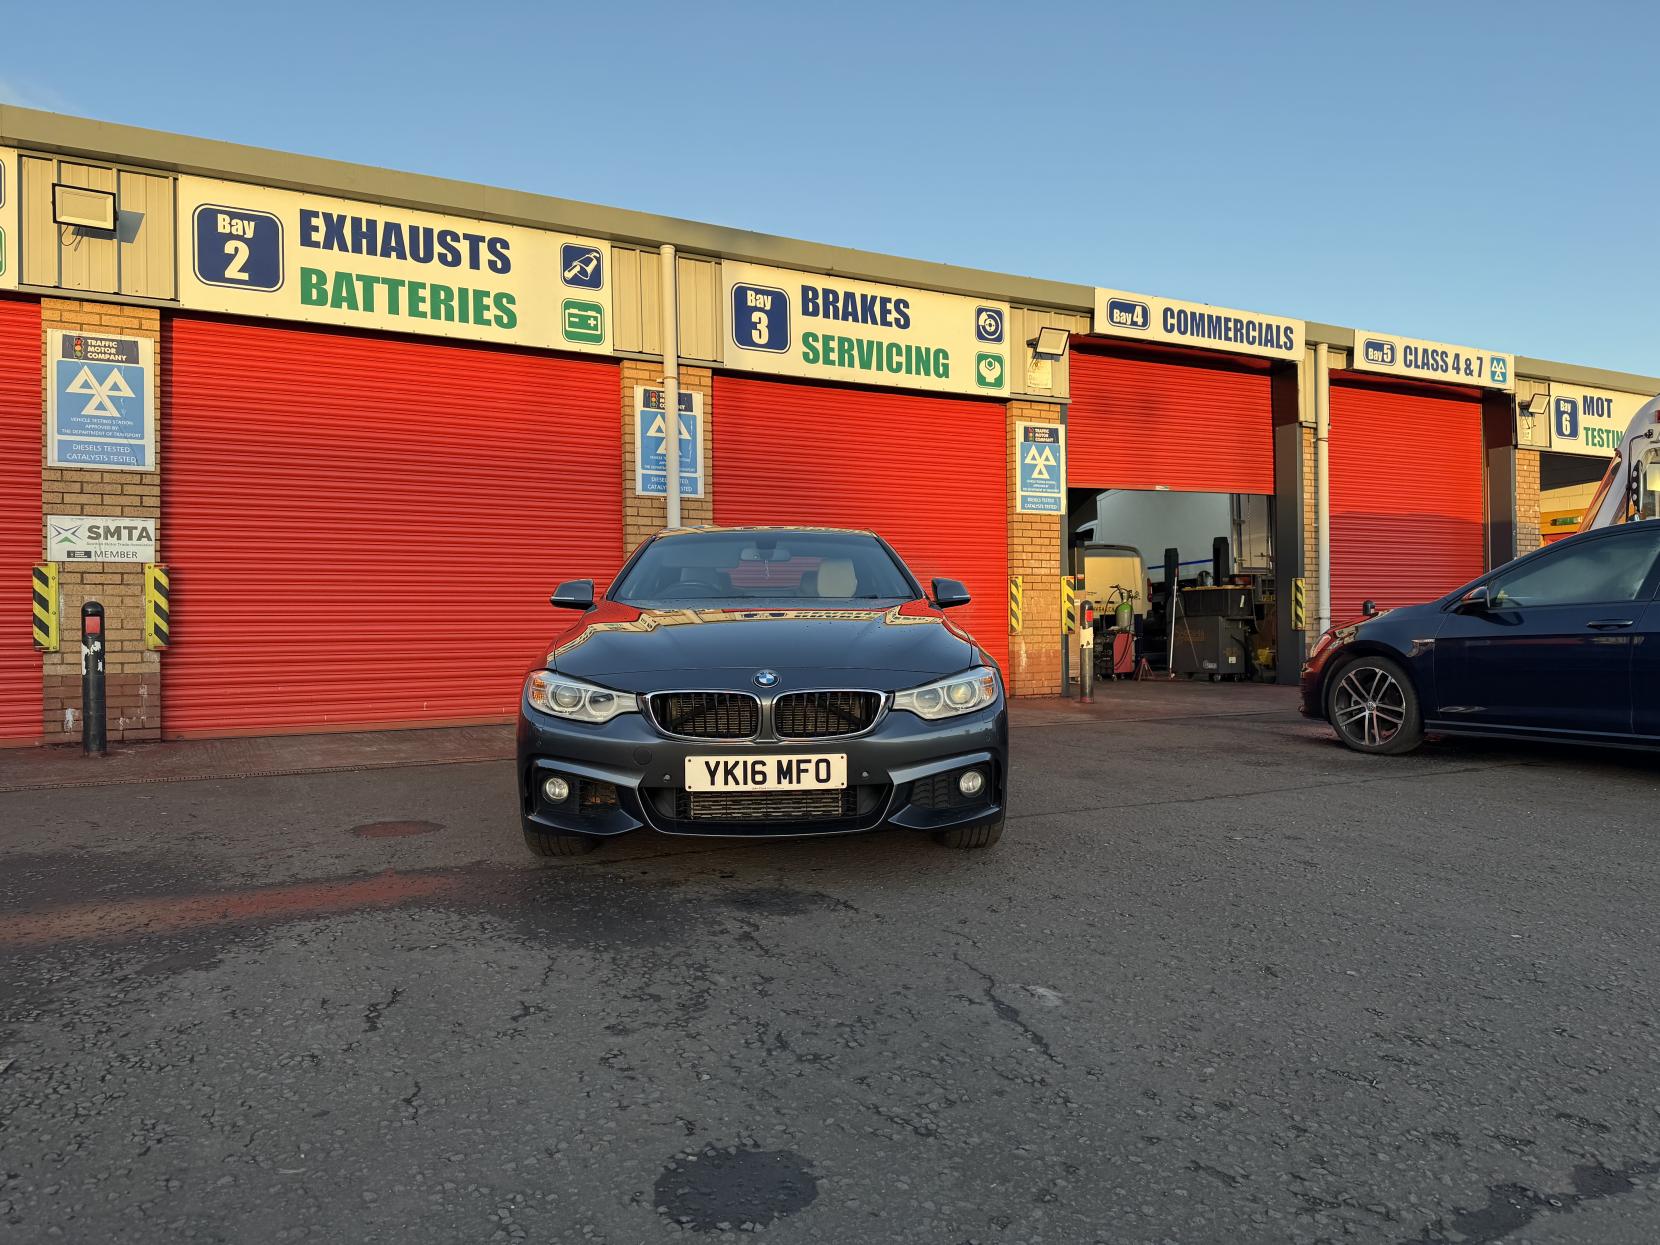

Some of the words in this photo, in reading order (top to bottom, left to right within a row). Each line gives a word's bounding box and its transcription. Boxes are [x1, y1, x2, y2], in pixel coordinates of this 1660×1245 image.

[217, 214, 255, 239] Bay
[299, 208, 512, 275] EXHAUSTS
[224, 240, 250, 280] 2
[300, 266, 518, 330] BATTERIES
[746, 290, 772, 310] Bay
[800, 284, 910, 330] BRAKES
[1113, 308, 1132, 325] Bay
[1132, 306, 1144, 326] 4
[751, 311, 769, 345] 3
[1162, 306, 1294, 351] COMMERCIALS
[87, 340, 118, 348] TRAFFIC
[801, 331, 950, 379] SERVICING
[1368, 348, 1382, 362] Bay
[1383, 344, 1392, 363] 5
[87, 352, 128, 362] COMPANY
[1403, 345, 1449, 373] CLASS
[1452, 352, 1461, 375] 4
[1464, 358, 1474, 377] &
[1476, 356, 1484, 378] 7
[1560, 400, 1572, 413] Bay
[1582, 395, 1614, 418] MOT
[1562, 414, 1571, 435] 6
[1583, 426, 1624, 448] TESTIN
[66, 453, 108, 461] CATALYSTS
[86, 524, 152, 542] SMTA
[94, 550, 138, 559] MEMBER
[704, 760, 768, 786] YK16
[776, 758, 832, 785] MFO
